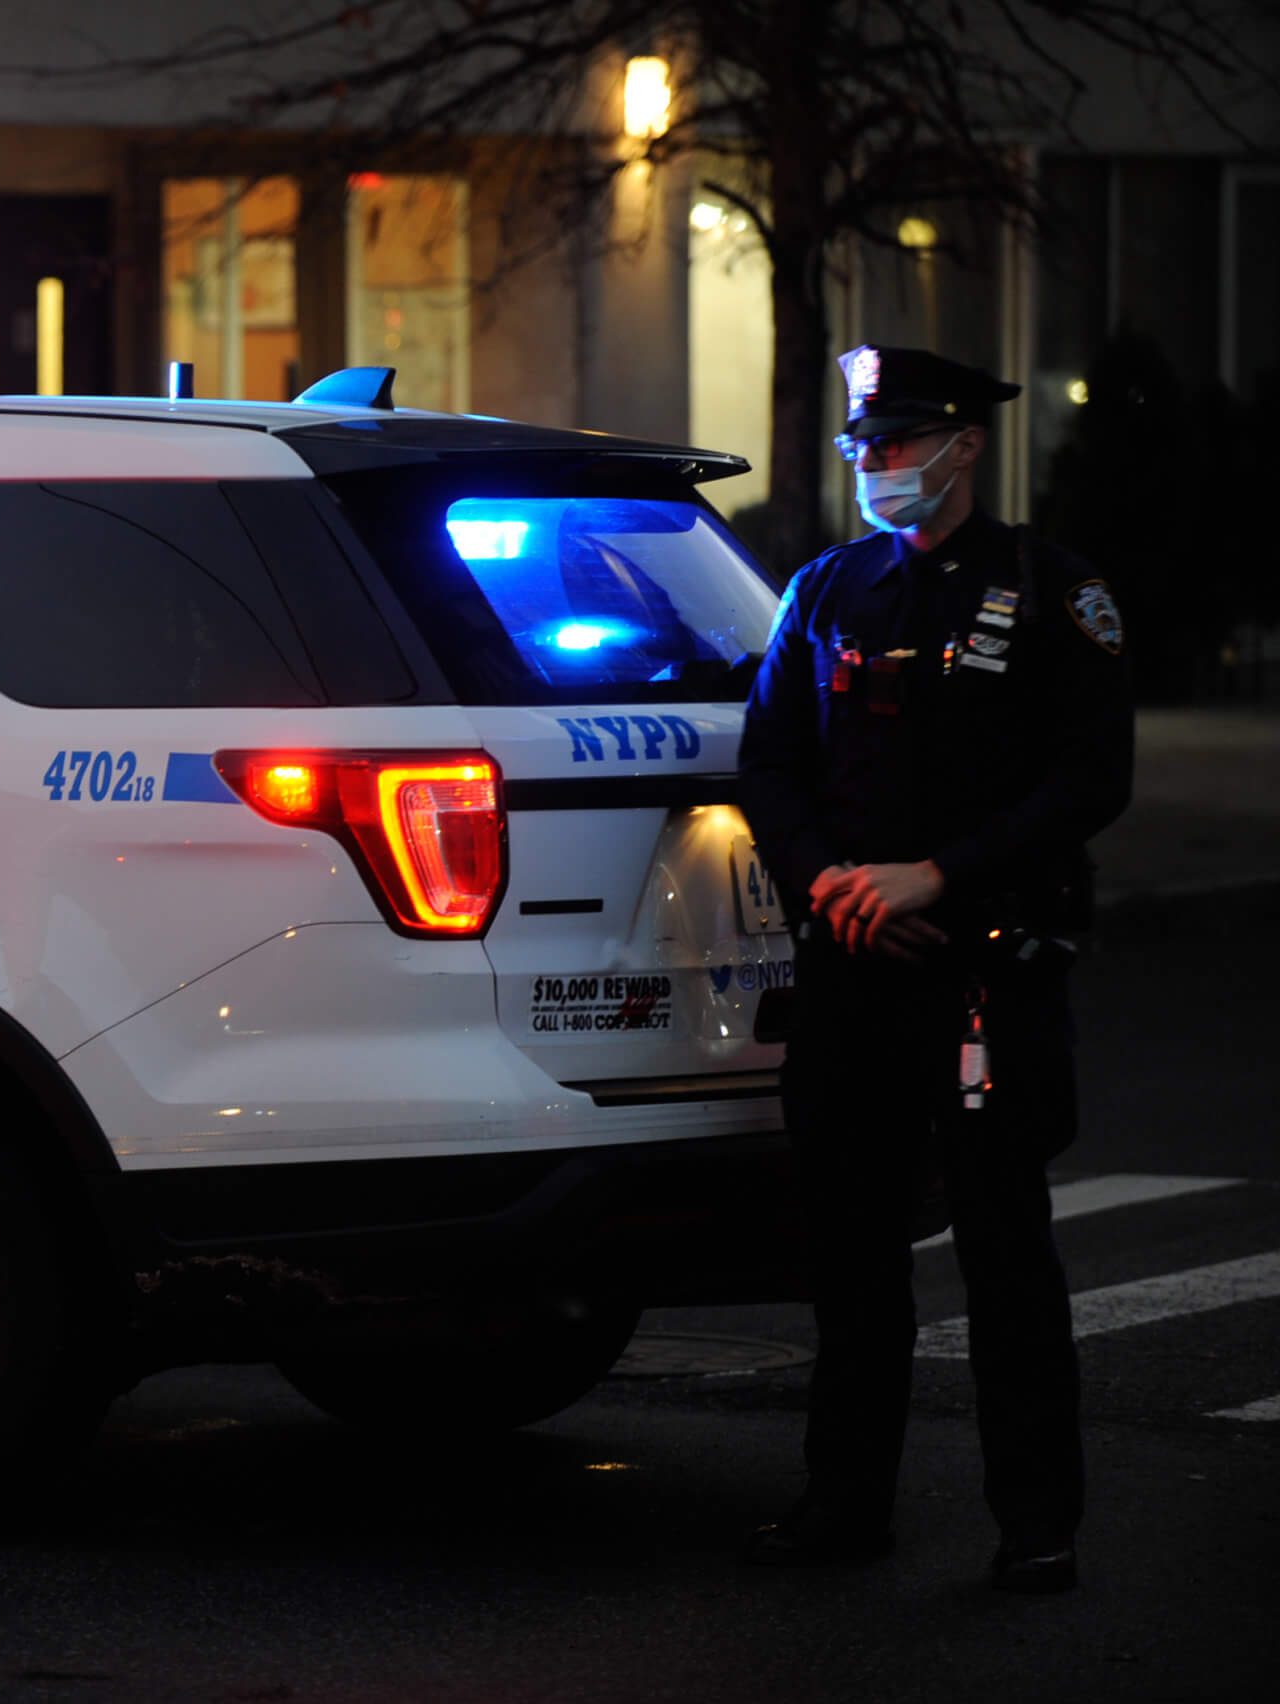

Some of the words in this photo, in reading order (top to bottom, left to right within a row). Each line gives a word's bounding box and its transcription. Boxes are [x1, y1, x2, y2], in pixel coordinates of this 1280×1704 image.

[555, 715, 701, 762] NYPD
[43, 750, 137, 802] 4702
[533, 976, 599, 1005] $10,000
[604, 976, 671, 1000] REWARD
[735, 960, 798, 992] @NYP
[532, 1014, 559, 1032] CALL
[563, 1013, 594, 1031] 1-800
